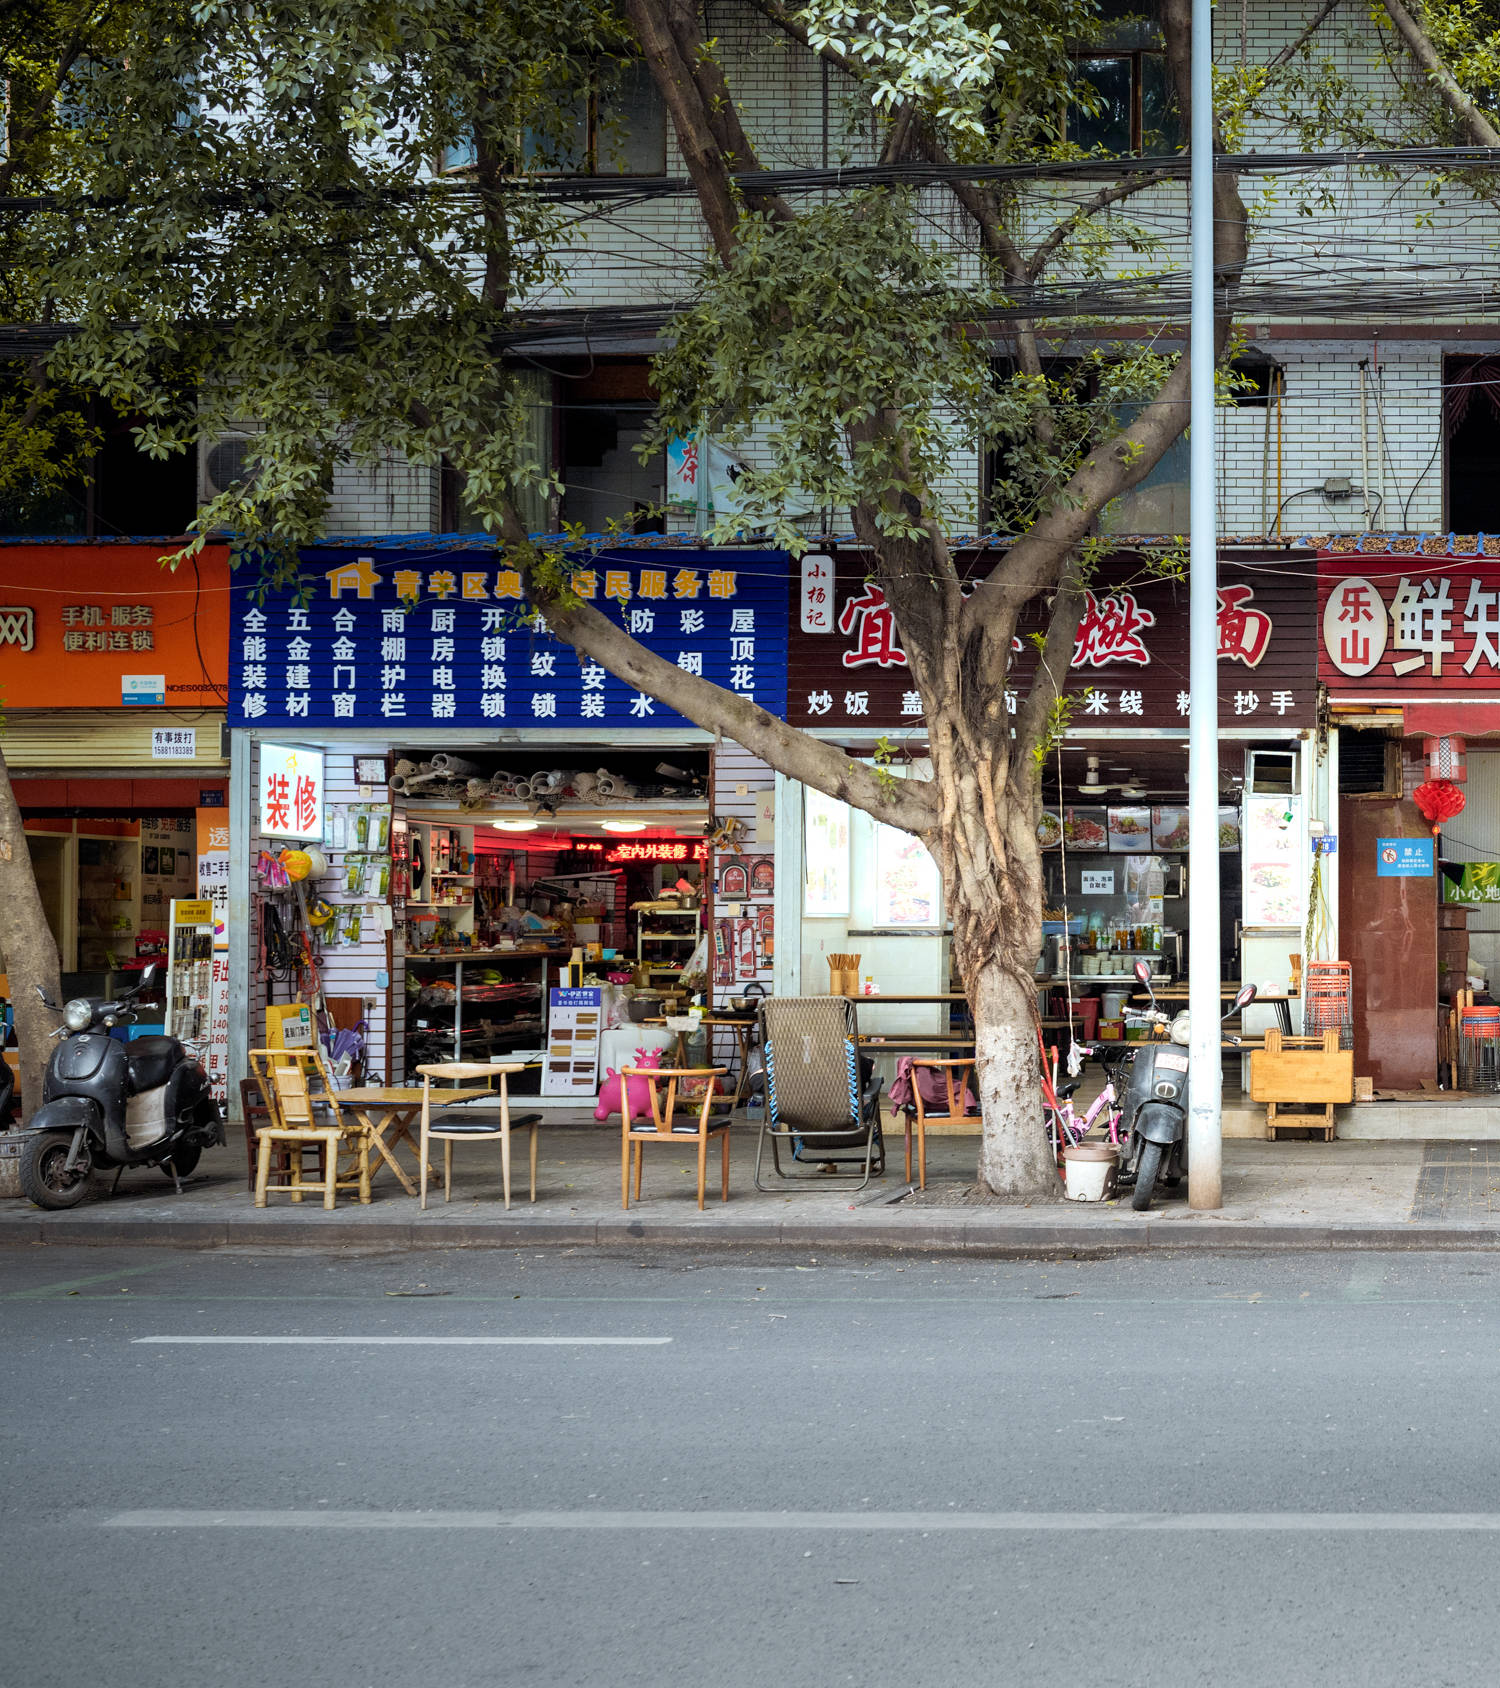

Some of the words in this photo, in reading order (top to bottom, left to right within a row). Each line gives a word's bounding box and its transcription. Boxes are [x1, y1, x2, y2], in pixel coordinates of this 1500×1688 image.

[393, 569, 738, 599] 青羊区奥居民服务部
[806, 563, 827, 627] 小杨记
[63, 630, 154, 651] 便利连锁
[242, 608, 268, 718] 全能装修
[286, 608, 312, 718] 五金建材
[331, 608, 357, 718] 合金门窗
[381, 608, 407, 718] 雨棚护栏
[431, 608, 456, 718] 厨房电器
[481, 608, 507, 718] 开锁换锁
[838, 583, 1273, 668] 宜燃面
[1337, 586, 1374, 665] 乐山
[154, 732, 193, 744] 有事拨打
[807, 690, 870, 716] 炒饭
[1085, 690, 1144, 716] 米线
[1233, 690, 1296, 716] 抄手
[267, 773, 317, 832] 装修
[617, 843, 688, 859] 室内外装修
